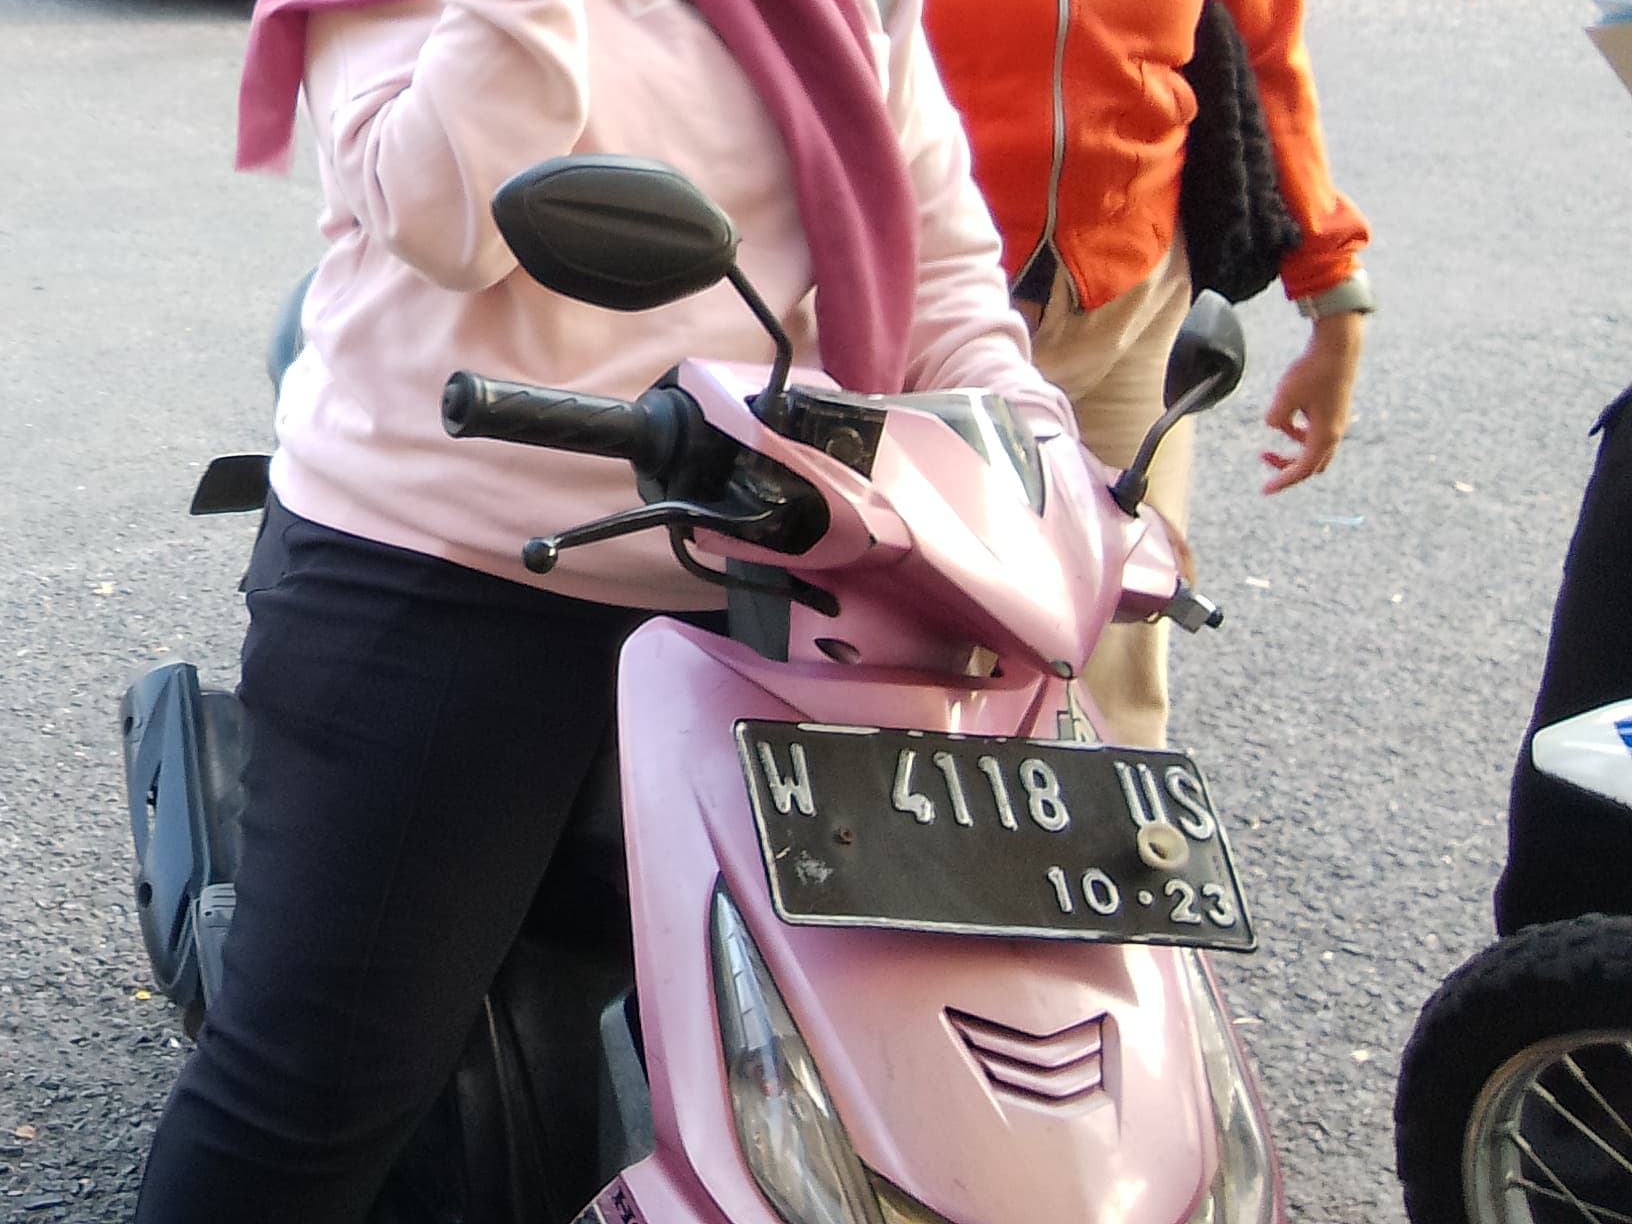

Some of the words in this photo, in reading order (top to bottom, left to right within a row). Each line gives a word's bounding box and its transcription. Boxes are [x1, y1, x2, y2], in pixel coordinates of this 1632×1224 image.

[757, 740, 816, 816] W
[891, 748, 1070, 831] 4118
[1113, 760, 1215, 840] US
